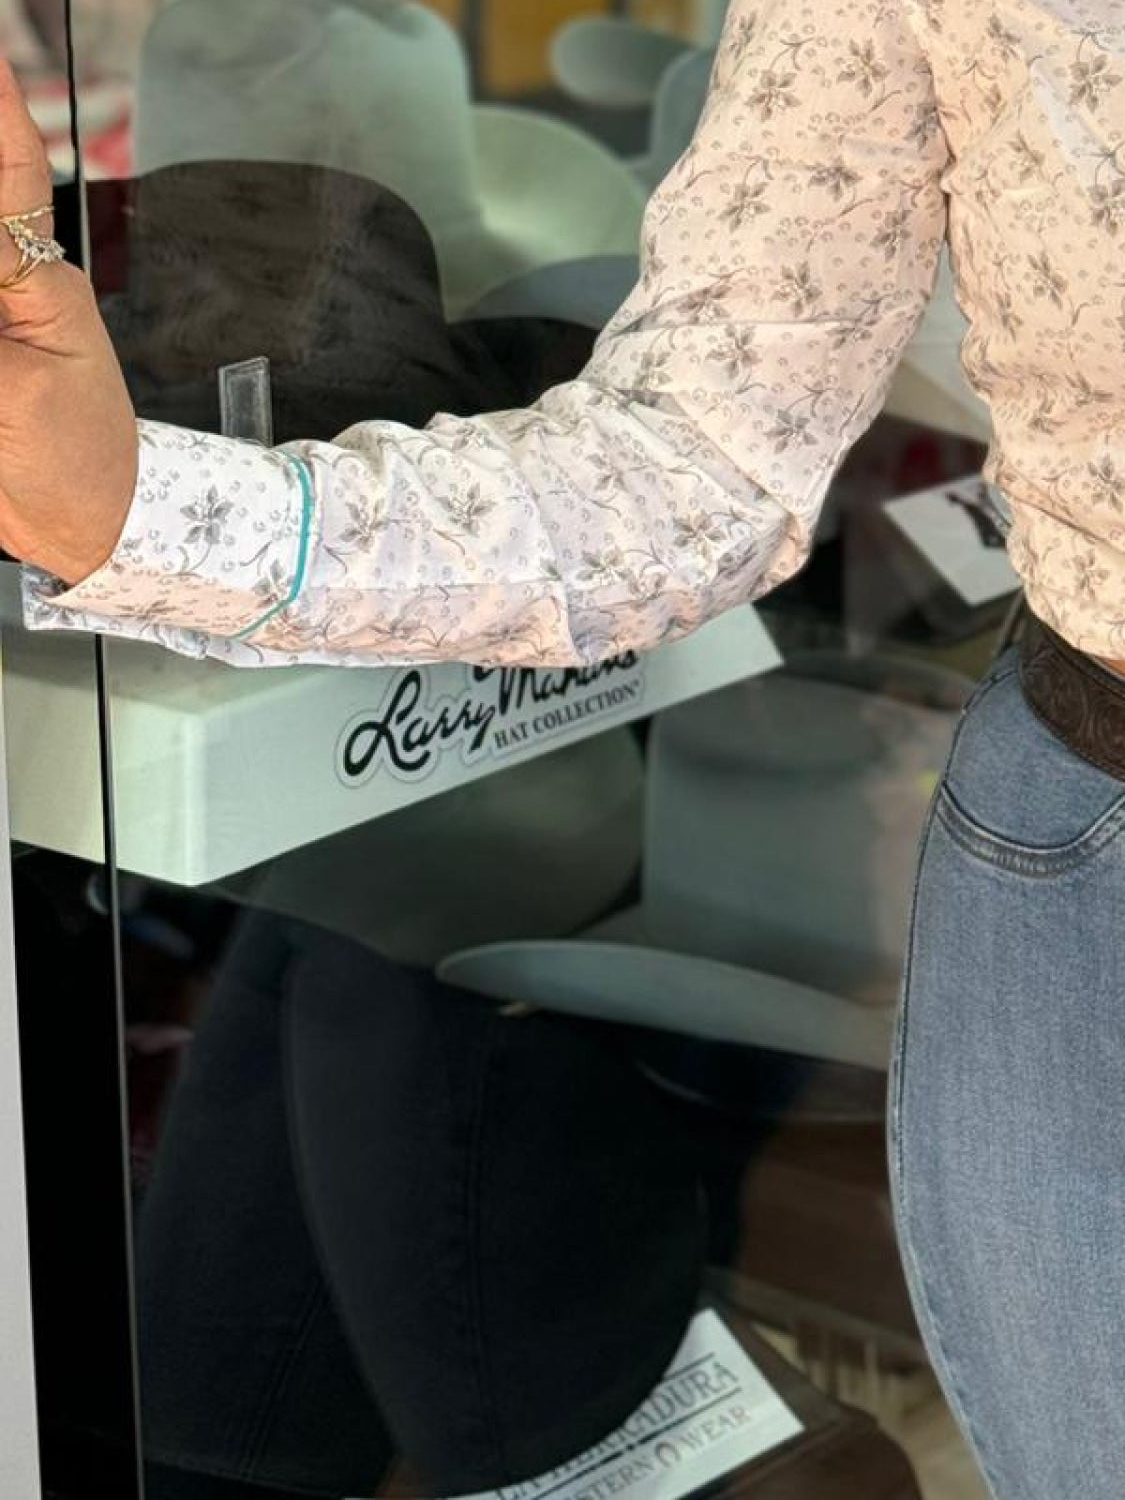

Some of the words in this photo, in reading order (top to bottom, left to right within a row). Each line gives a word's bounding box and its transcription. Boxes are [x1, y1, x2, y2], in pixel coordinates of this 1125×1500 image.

[343, 670, 495, 776] Larry
[493, 722, 529, 749] HAT
[678, 1403, 751, 1451] WEAR
